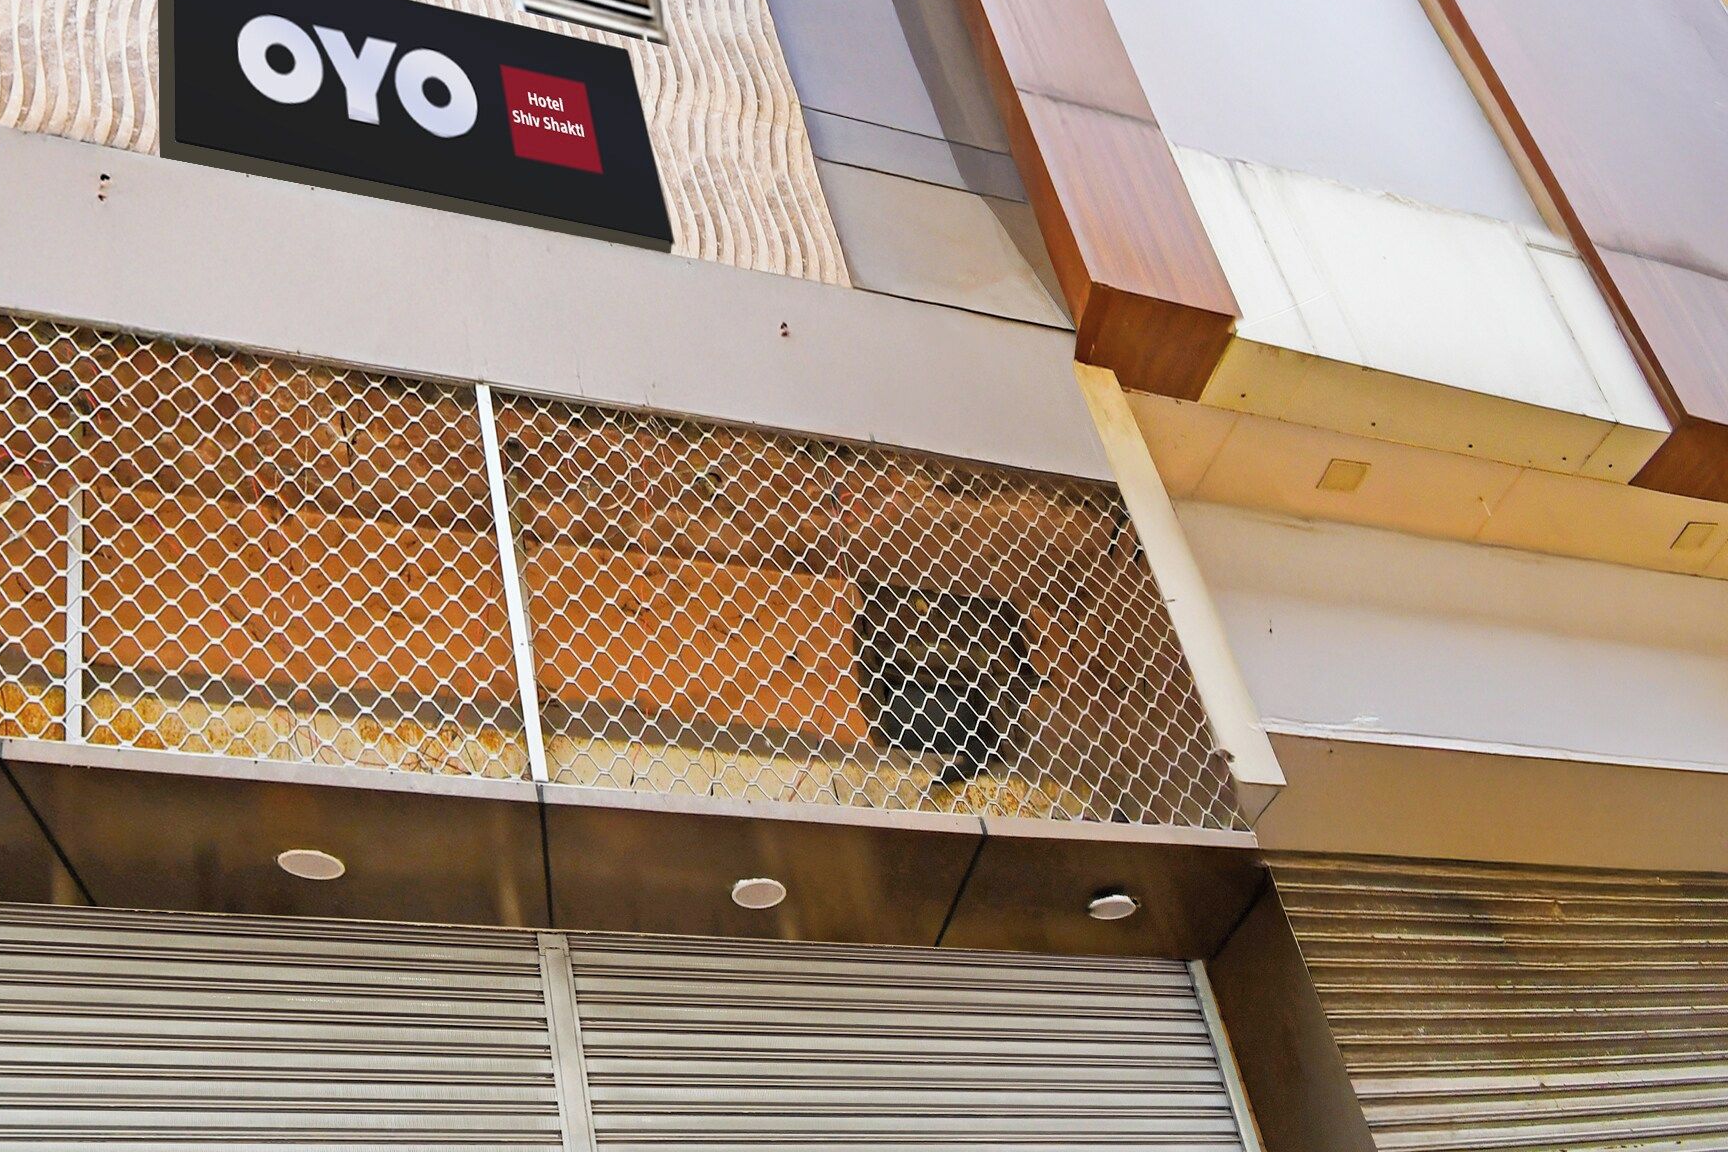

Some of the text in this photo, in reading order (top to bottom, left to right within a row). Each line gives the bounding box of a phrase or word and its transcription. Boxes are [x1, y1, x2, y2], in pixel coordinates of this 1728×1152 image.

[236, 14, 479, 139] OYO
[527, 91, 565, 113] Hotel
[512, 109, 586, 138] Shiv Shakti
